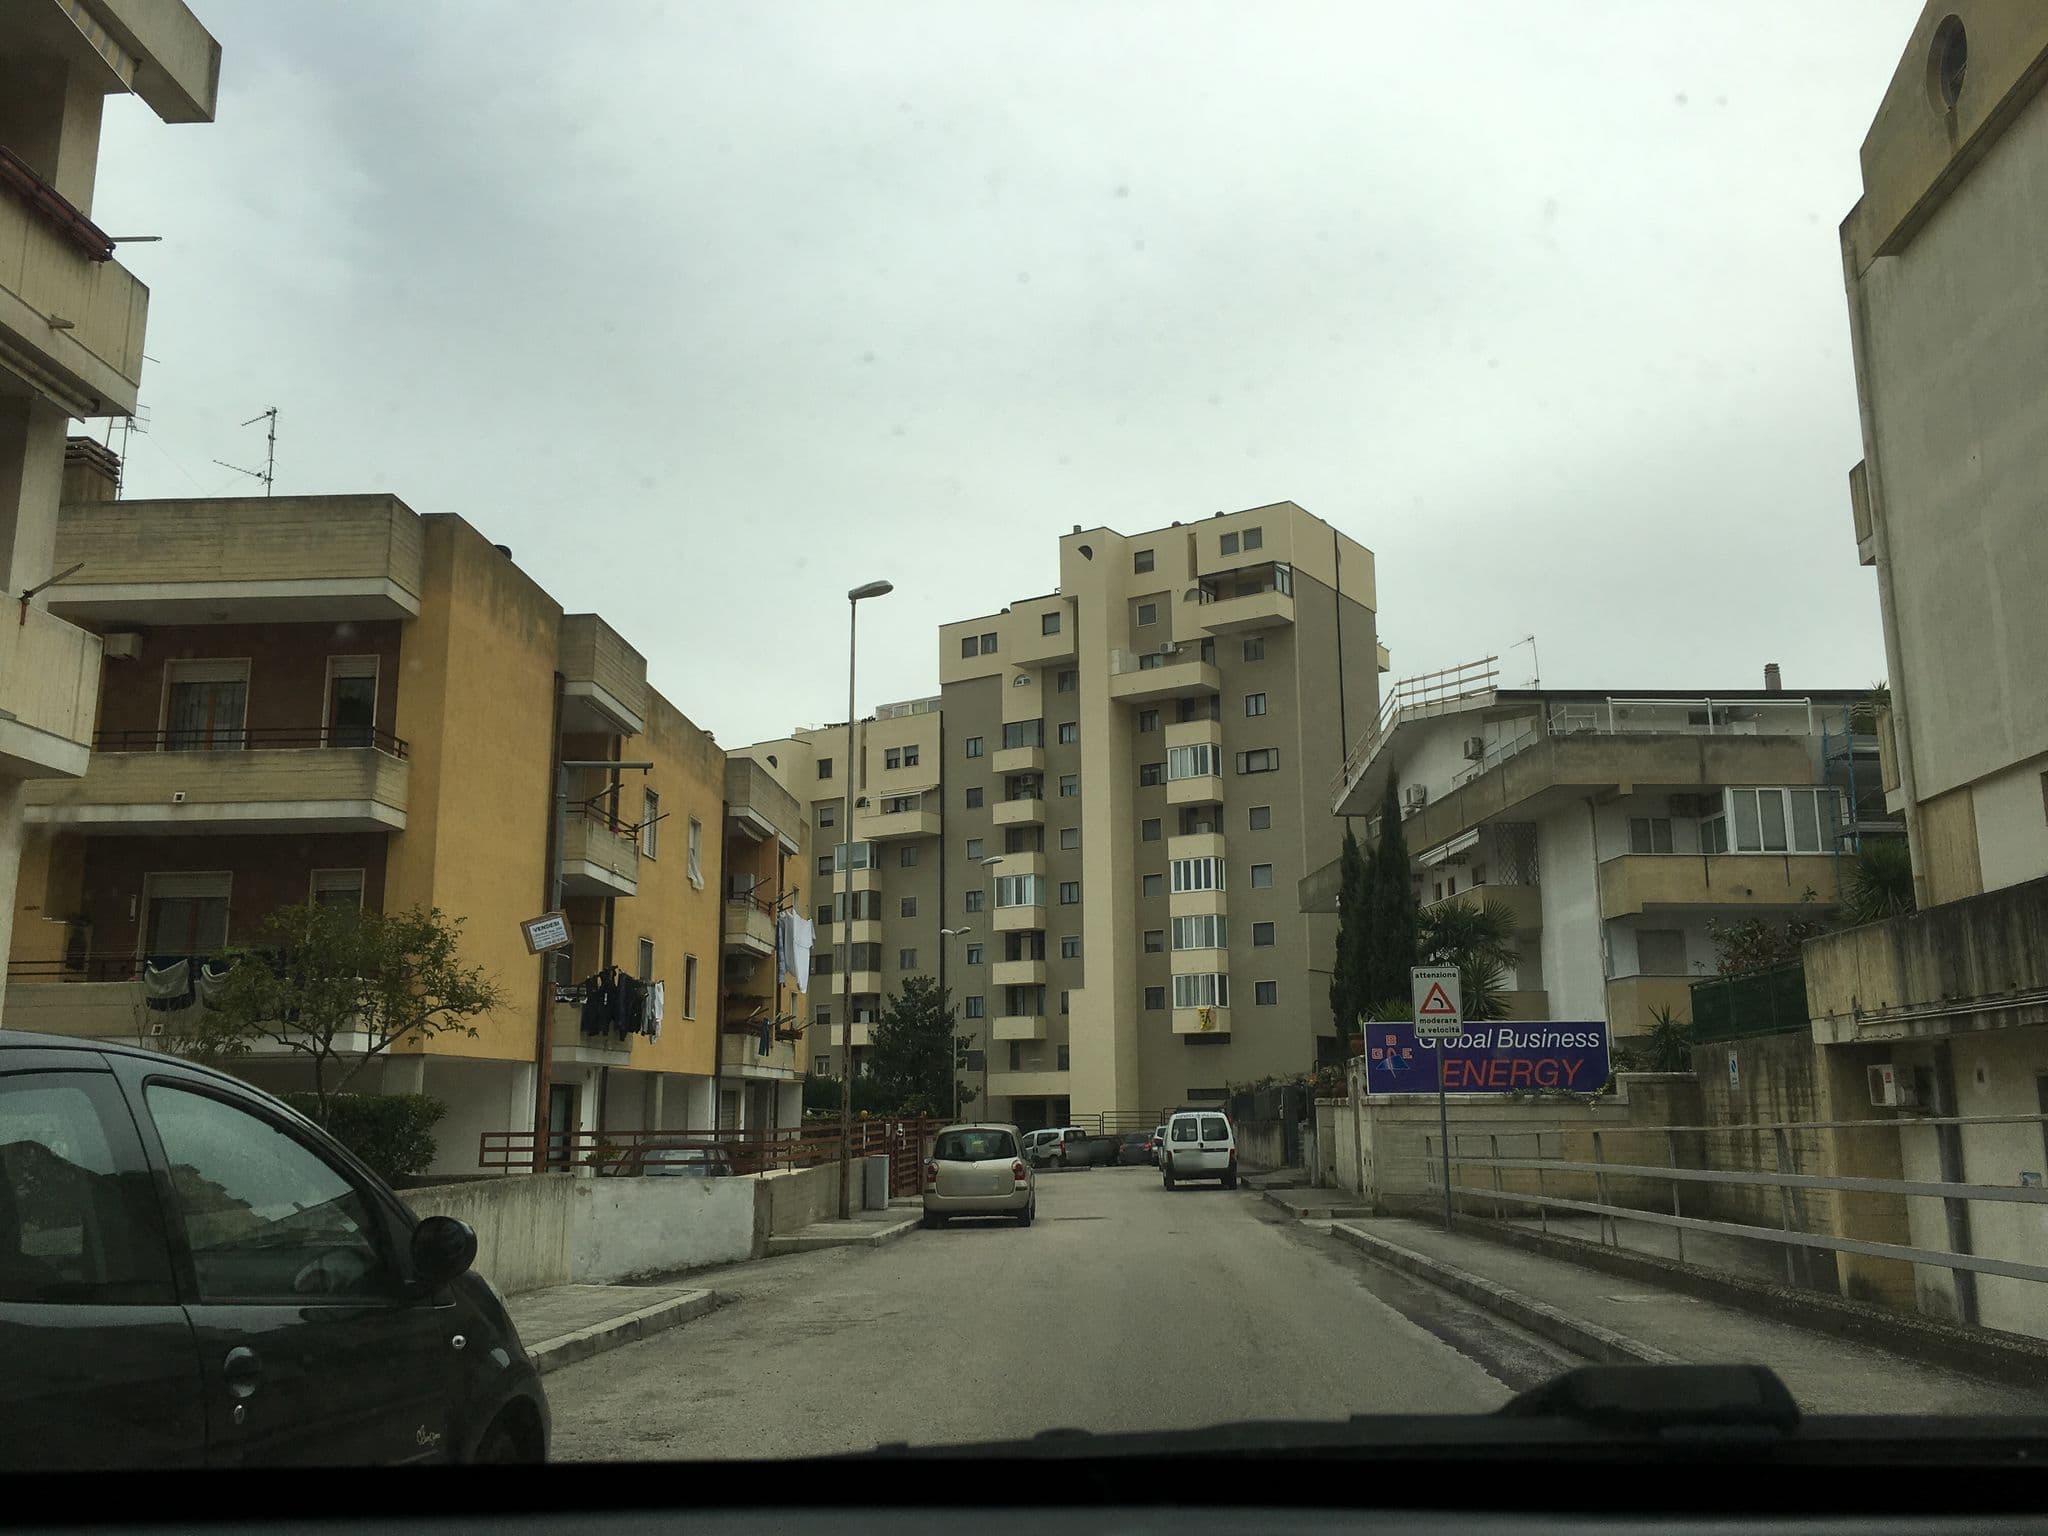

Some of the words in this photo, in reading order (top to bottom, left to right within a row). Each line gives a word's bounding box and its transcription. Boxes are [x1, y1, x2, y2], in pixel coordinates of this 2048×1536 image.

[1419, 1028, 1493, 1049] Gobal
[1497, 1029, 1600, 1049] Business
[1442, 1058, 1584, 1086] ENERGY
